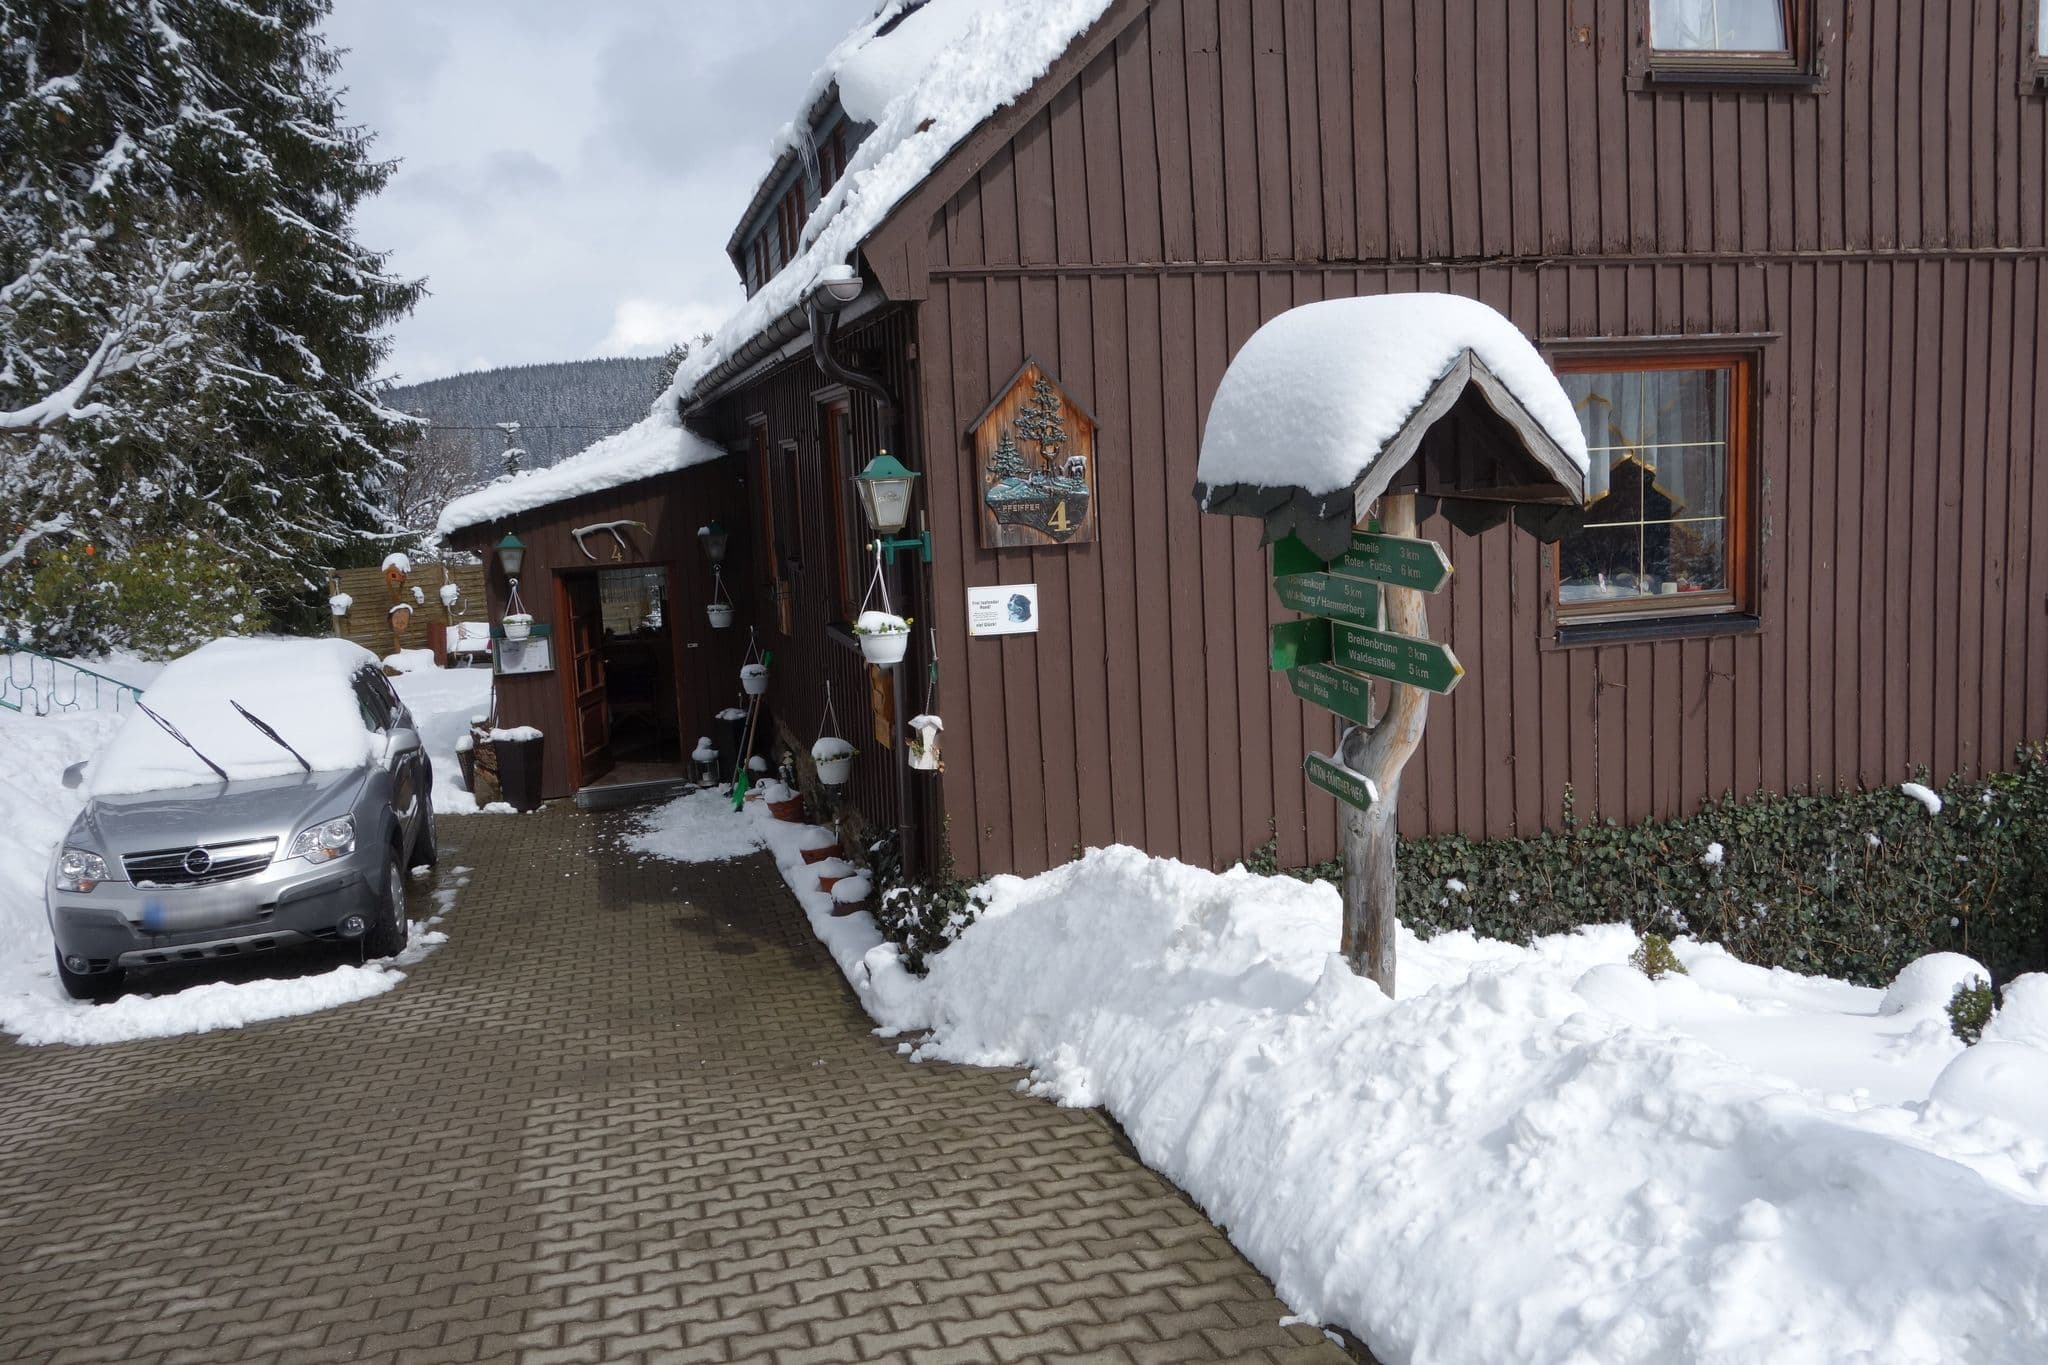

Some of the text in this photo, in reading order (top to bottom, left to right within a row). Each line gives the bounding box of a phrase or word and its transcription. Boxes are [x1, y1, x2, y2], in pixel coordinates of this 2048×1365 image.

[1048, 500, 1071, 532] 4
[611, 544, 622, 561] 4
[1406, 548, 1420, 560] km
[1344, 554, 1364, 568] Roter
[1369, 559, 1393, 574] Fuchs
[1407, 566, 1421, 579] km
[1344, 584, 1350, 596] 5
[1350, 586, 1362, 599] km
[1321, 596, 1365, 618] Hammerberg
[1347, 632, 1398, 654] Breitenbrunn
[1414, 647, 1428, 662] km
[1348, 648, 1429, 680] Waldesstille 5 km
[1342, 679, 1350, 691] 12
[1350, 683, 1360, 696] km
